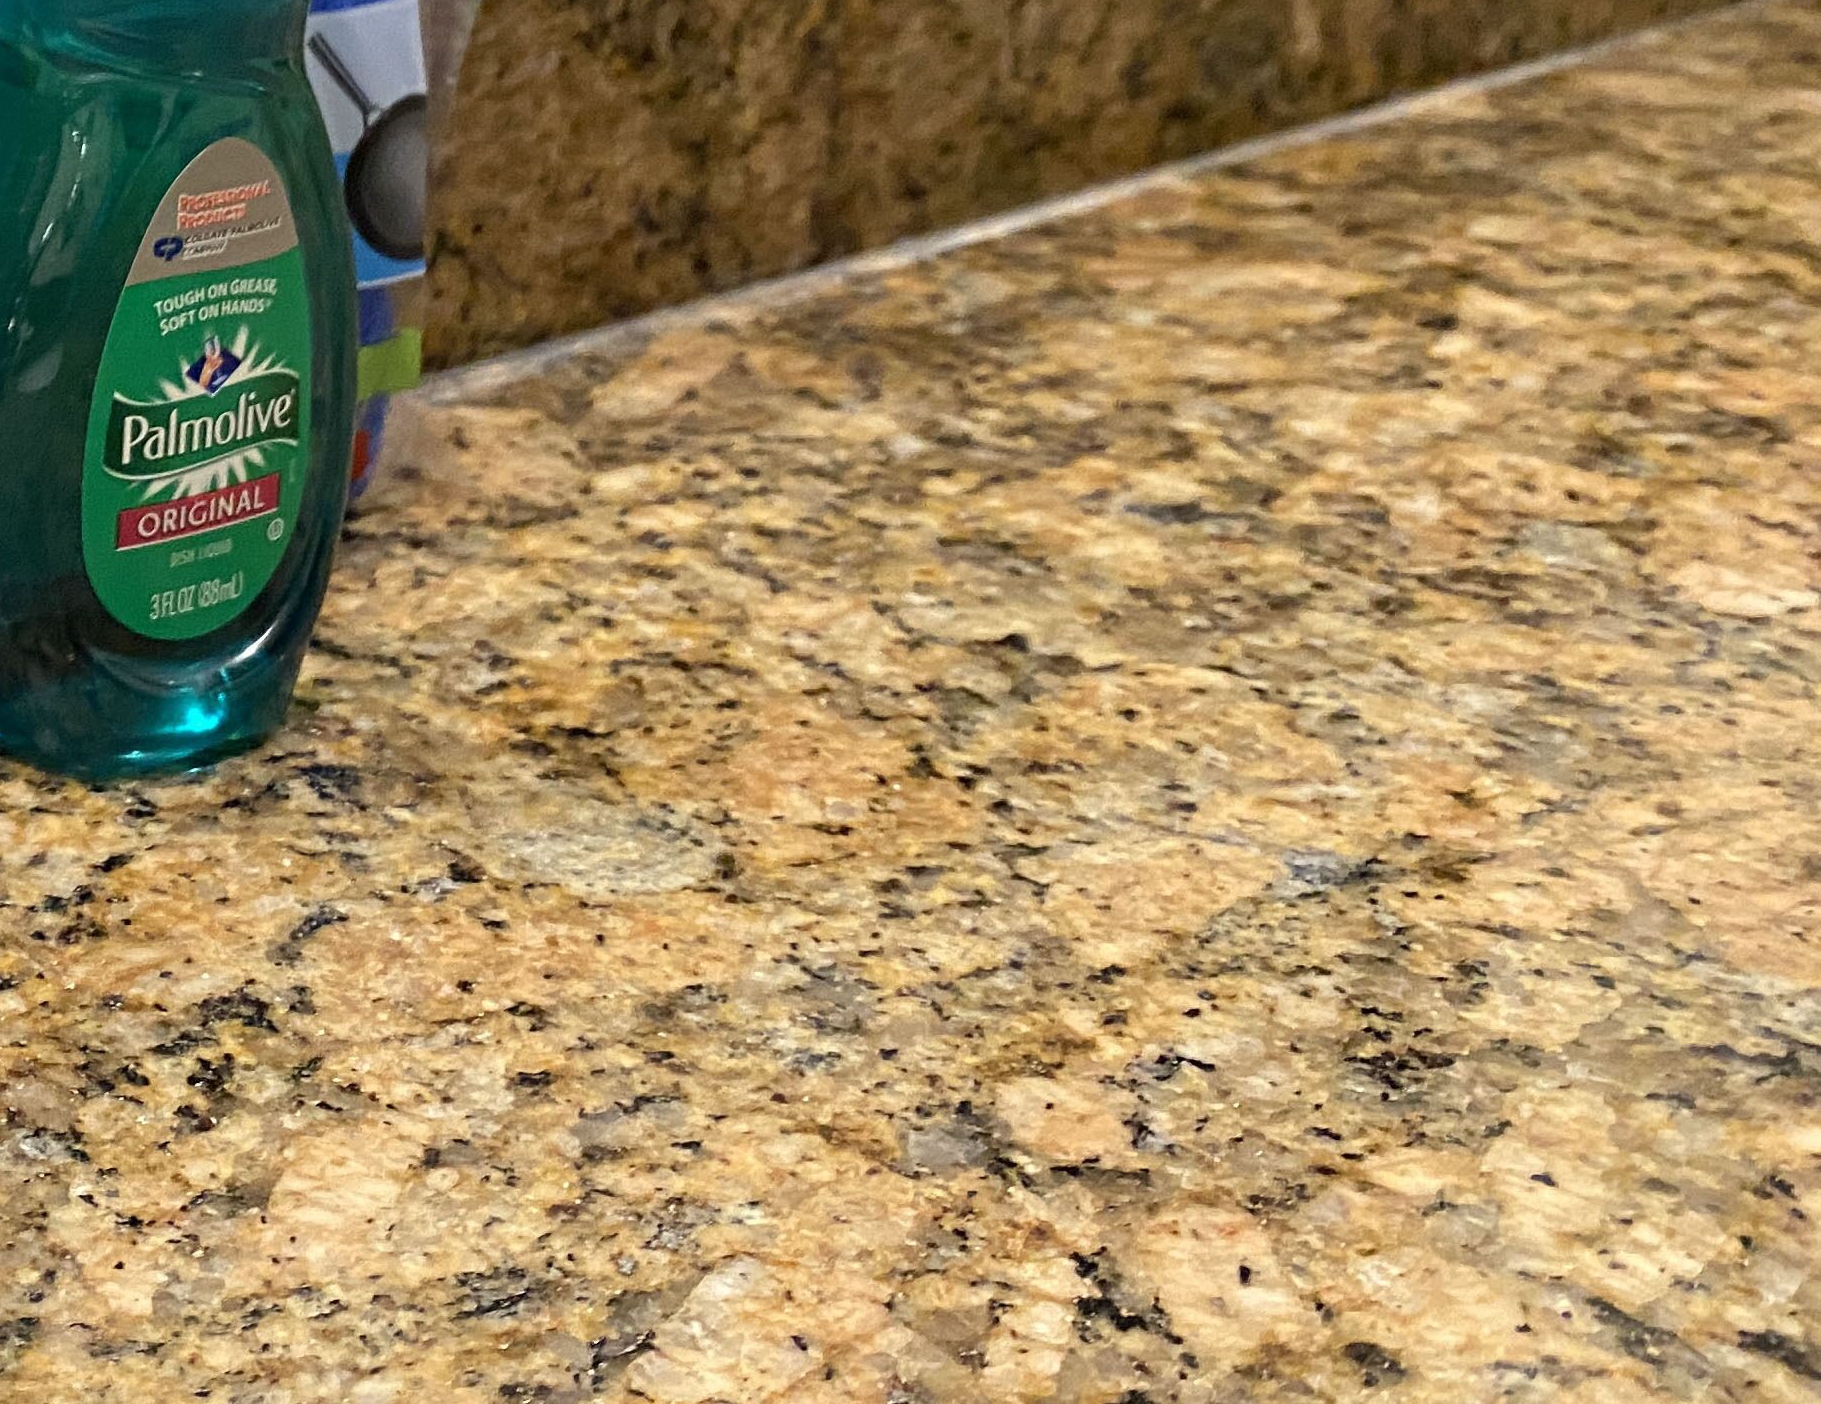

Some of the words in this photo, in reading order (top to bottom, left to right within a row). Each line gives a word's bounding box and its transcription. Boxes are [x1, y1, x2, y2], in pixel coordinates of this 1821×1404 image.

[153, 287, 204, 316] TOUGH
[207, 282, 228, 299] ON
[159, 309, 197, 336] SOFT
[198, 303, 219, 321] ON
[121, 392, 292, 465] Palmolive
[137, 486, 265, 538] ORIGINAL
[149, 594, 160, 620] 3
[161, 590, 177, 618] FL
[178, 585, 196, 614] OZ
